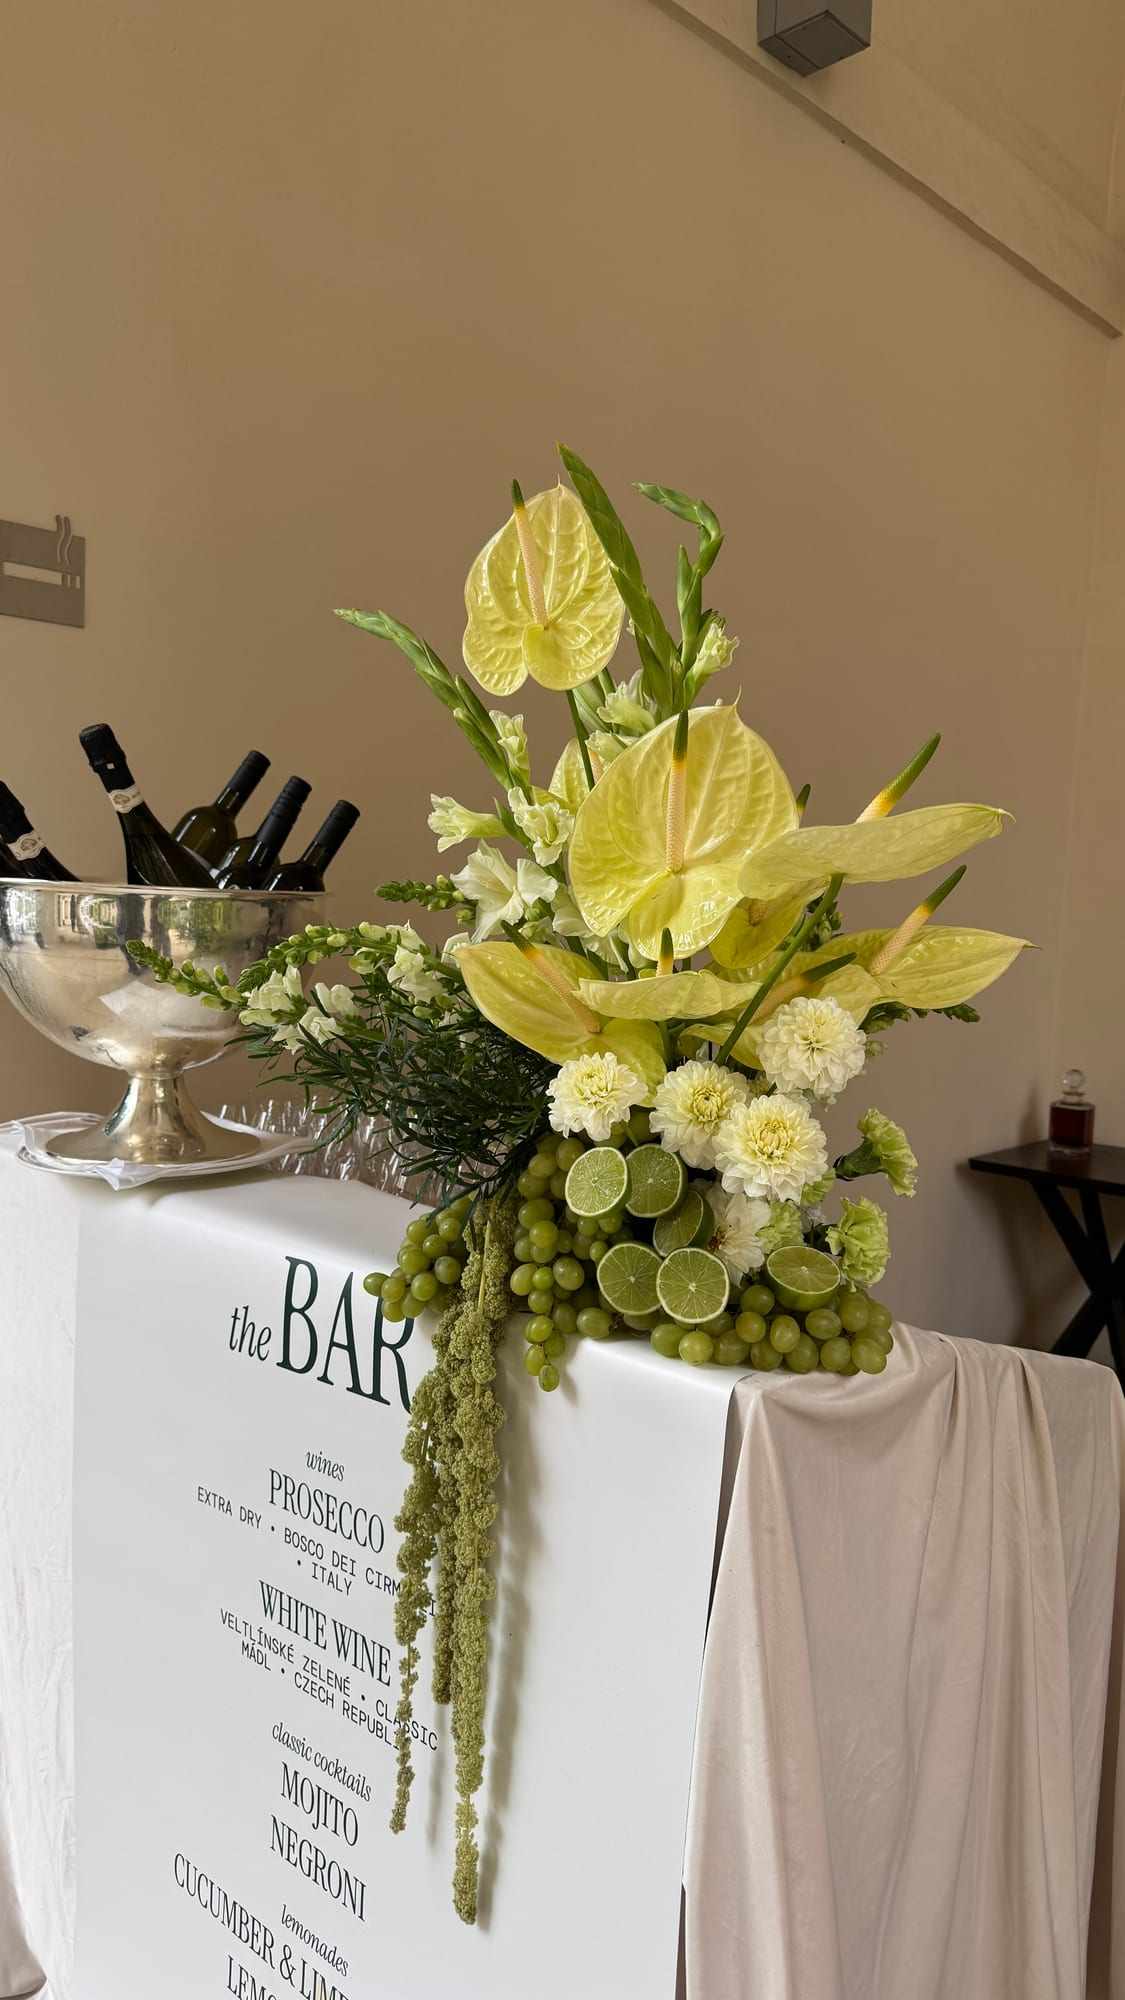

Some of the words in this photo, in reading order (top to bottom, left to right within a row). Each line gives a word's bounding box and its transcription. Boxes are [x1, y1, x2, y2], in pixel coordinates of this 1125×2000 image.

[228, 1304, 272, 1361] the
[276, 1256, 415, 1415] BAR
[306, 1450, 345, 1482] wines
[198, 1486, 232, 1516] EXTRA
[240, 1506, 261, 1528] DRY
[285, 1528, 323, 1560] BOSCO
[332, 1551, 356, 1576] DEI
[270, 1469, 384, 1553] PROSECCO
[312, 1562, 352, 1595] ITALY
[221, 1608, 294, 1664] VELTLÍNSKÉ
[303, 1656, 350, 1697] ZELENÉ
[242, 1641, 271, 1671] MÁDL
[295, 1672, 334, 1708] CZECH
[259, 1580, 327, 1650] WHITE
[332, 1619, 390, 1686] WINE
[272, 1722, 313, 1762] classic
[314, 1753, 371, 1801] cocktails
[281, 1762, 358, 1846] MOJITO
[270, 1815, 366, 1921] NEGRONI
[175, 1854, 275, 1969] CUCUMBER
[280, 1945, 296, 1987] &
[300, 1959, 348, 2000] LIM
[281, 1903, 349, 1977] lemonades
[227, 1956, 276, 2000] LEM
